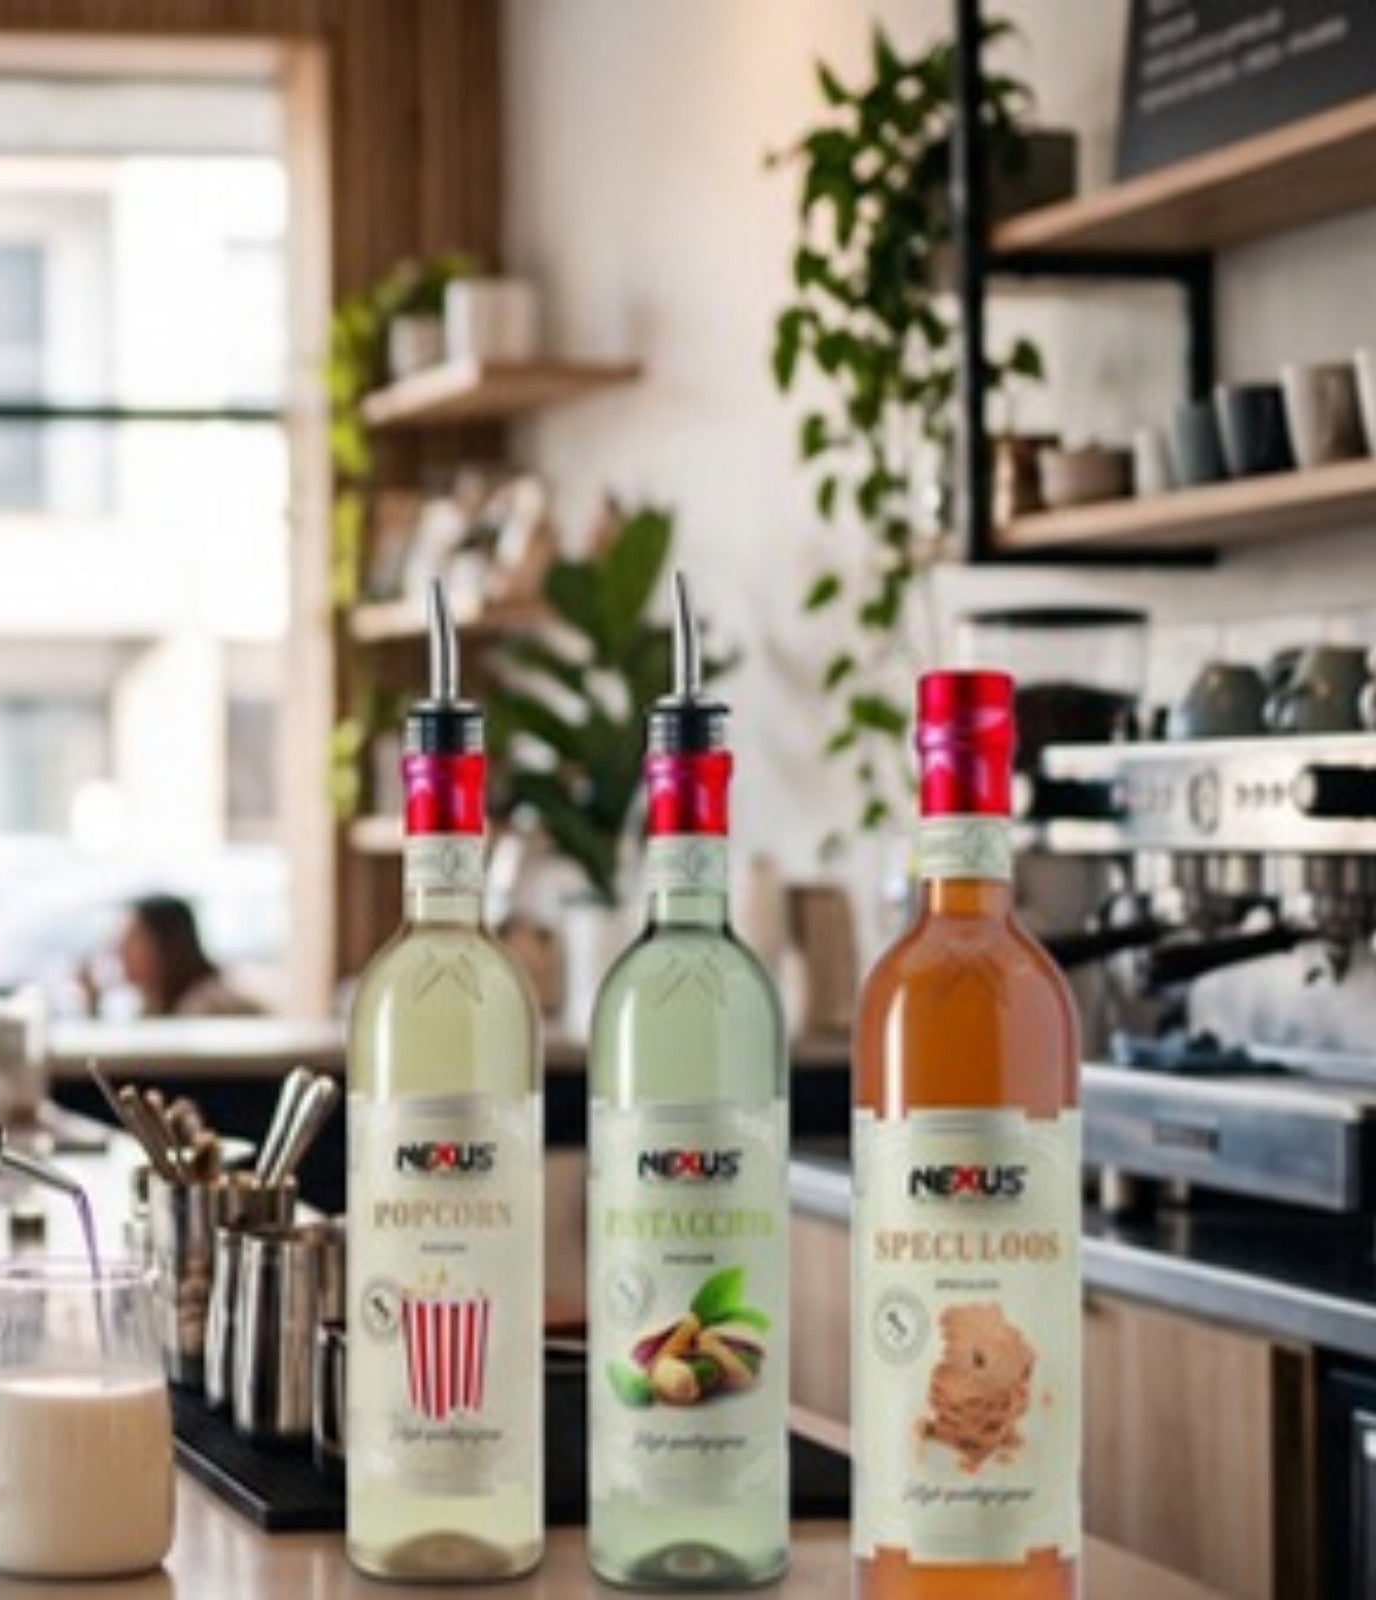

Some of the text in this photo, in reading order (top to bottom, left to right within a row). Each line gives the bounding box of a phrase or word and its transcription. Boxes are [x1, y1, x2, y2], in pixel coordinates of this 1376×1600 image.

[397, 1142, 497, 1172] NEXUS
[638, 1149, 741, 1179] NEXUS
[909, 1164, 1025, 1196] NEXUS
[374, 1200, 512, 1229] POPCORN
[874, 1231, 1061, 1264] SPECULOOS
